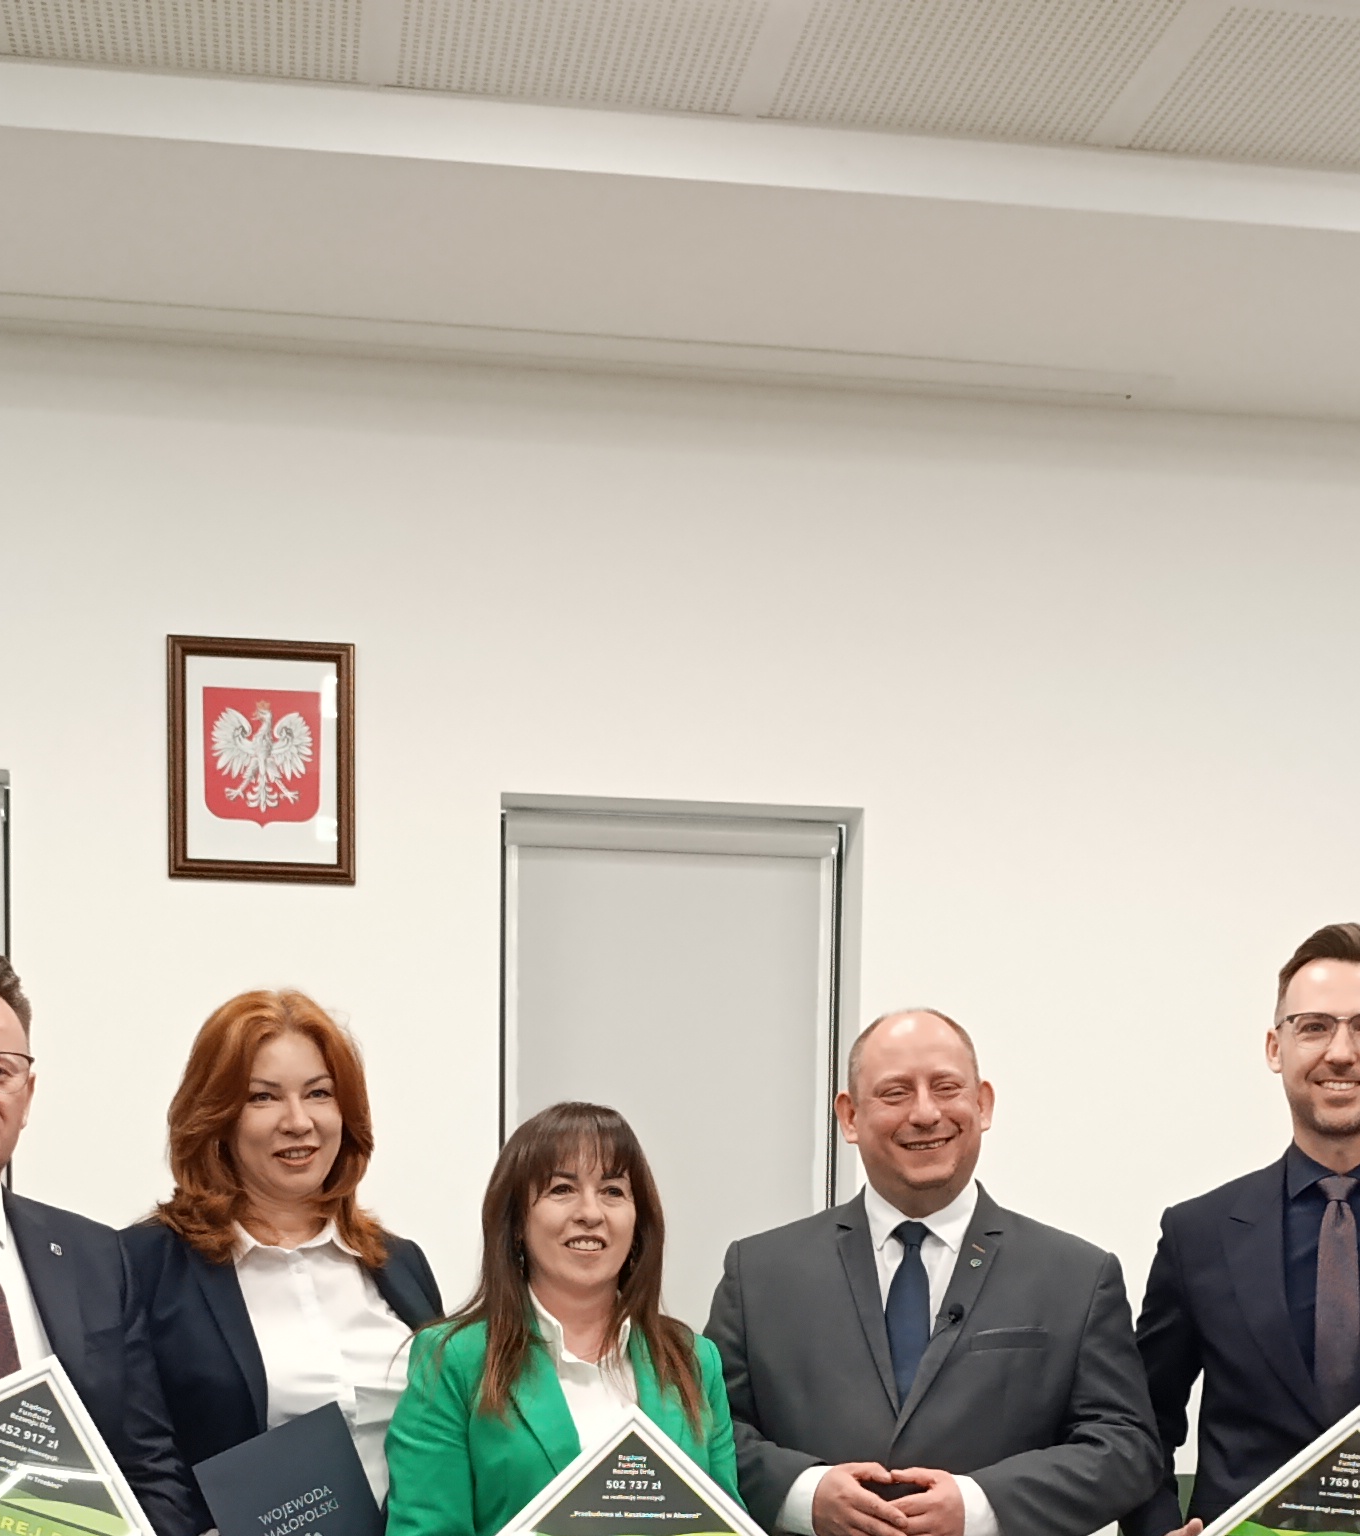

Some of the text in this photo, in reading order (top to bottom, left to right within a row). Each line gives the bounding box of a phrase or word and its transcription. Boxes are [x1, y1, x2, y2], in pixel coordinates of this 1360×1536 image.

[23, 1431, 46, 1444] 917
[47, 1438, 59, 1449] zł
[606, 1480, 662, 1490] 502 737 zł
[1319, 1476, 1326, 1485] 1
[1329, 1477, 1349, 1487] 769
[258, 1485, 332, 1525] WOJEWODA
